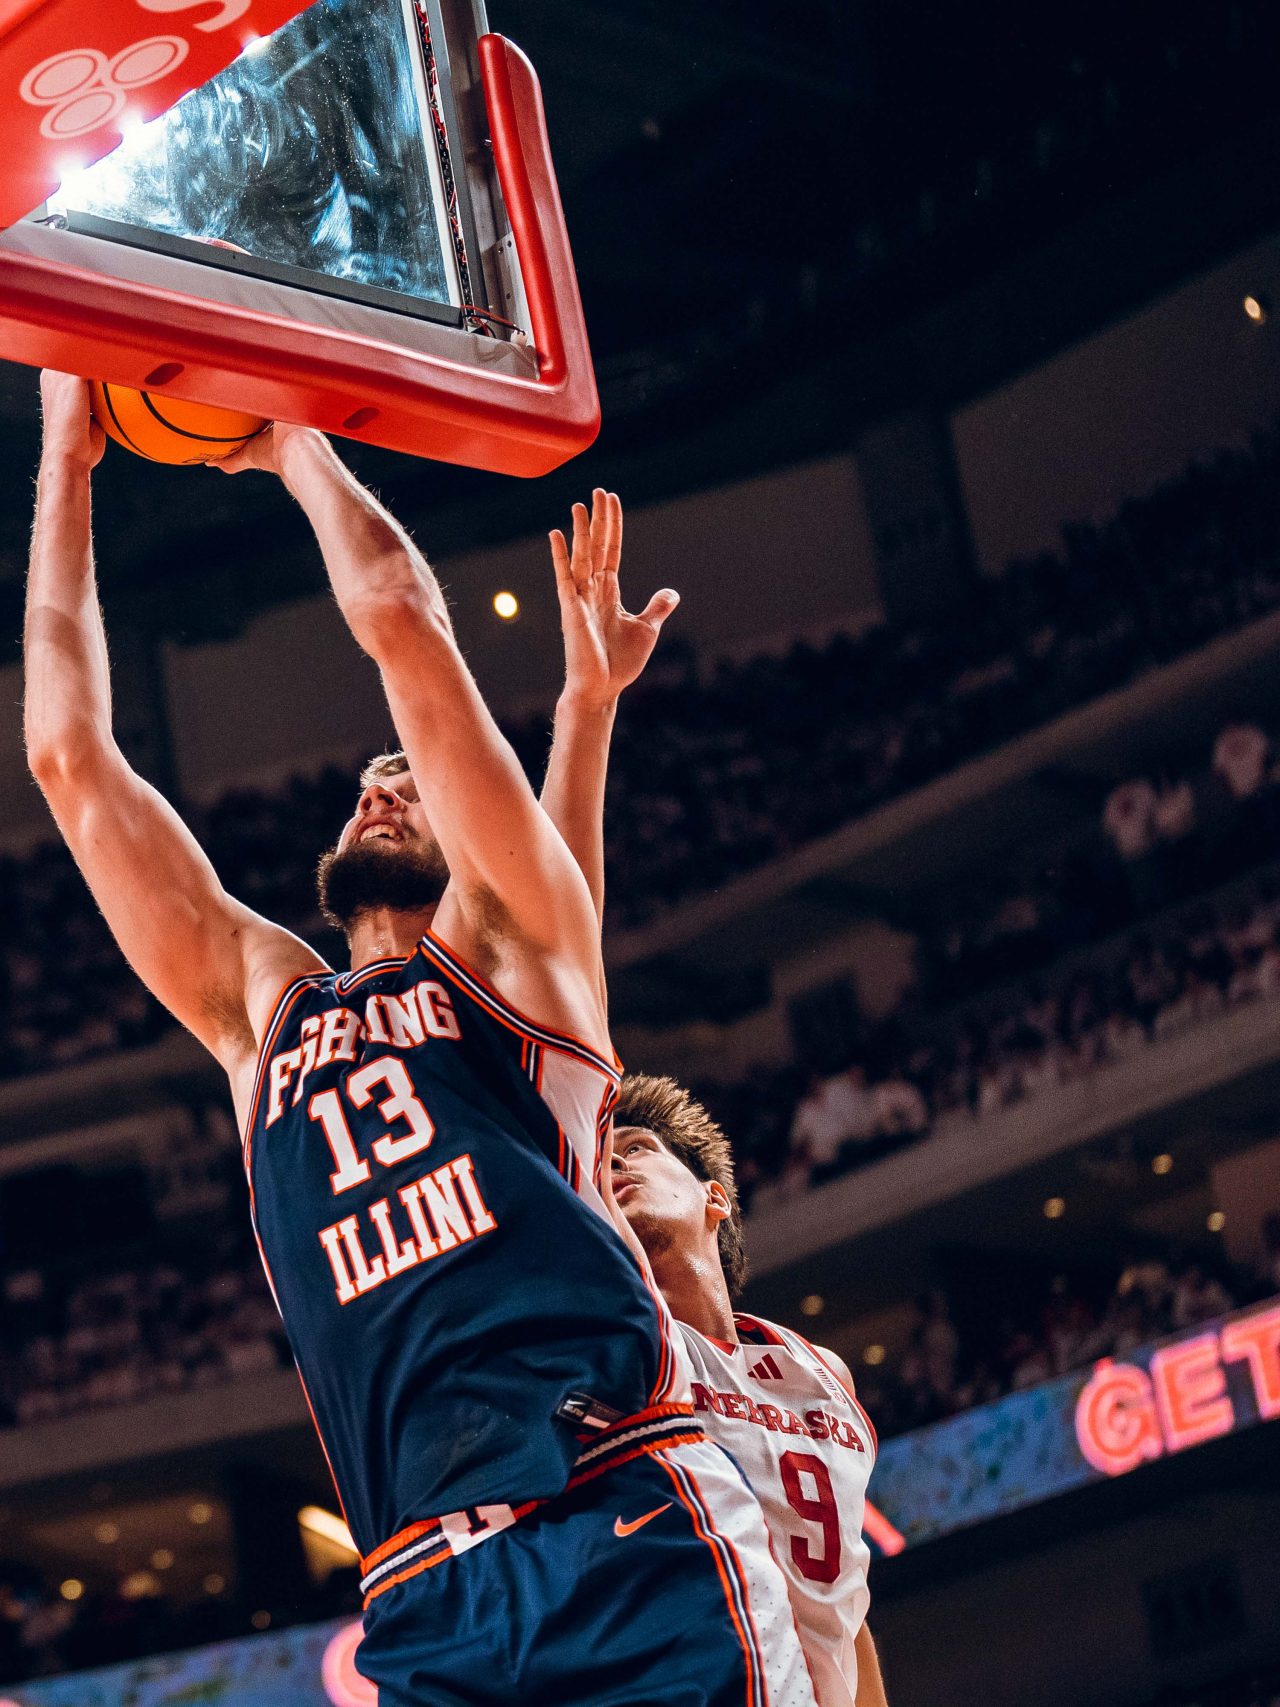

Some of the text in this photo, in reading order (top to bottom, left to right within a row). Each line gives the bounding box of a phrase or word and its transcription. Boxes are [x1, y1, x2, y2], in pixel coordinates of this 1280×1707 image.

[308, 1054, 436, 1196] 13
[318, 1153, 498, 1305] ILLINI
[779, 1449, 841, 1584] 9
